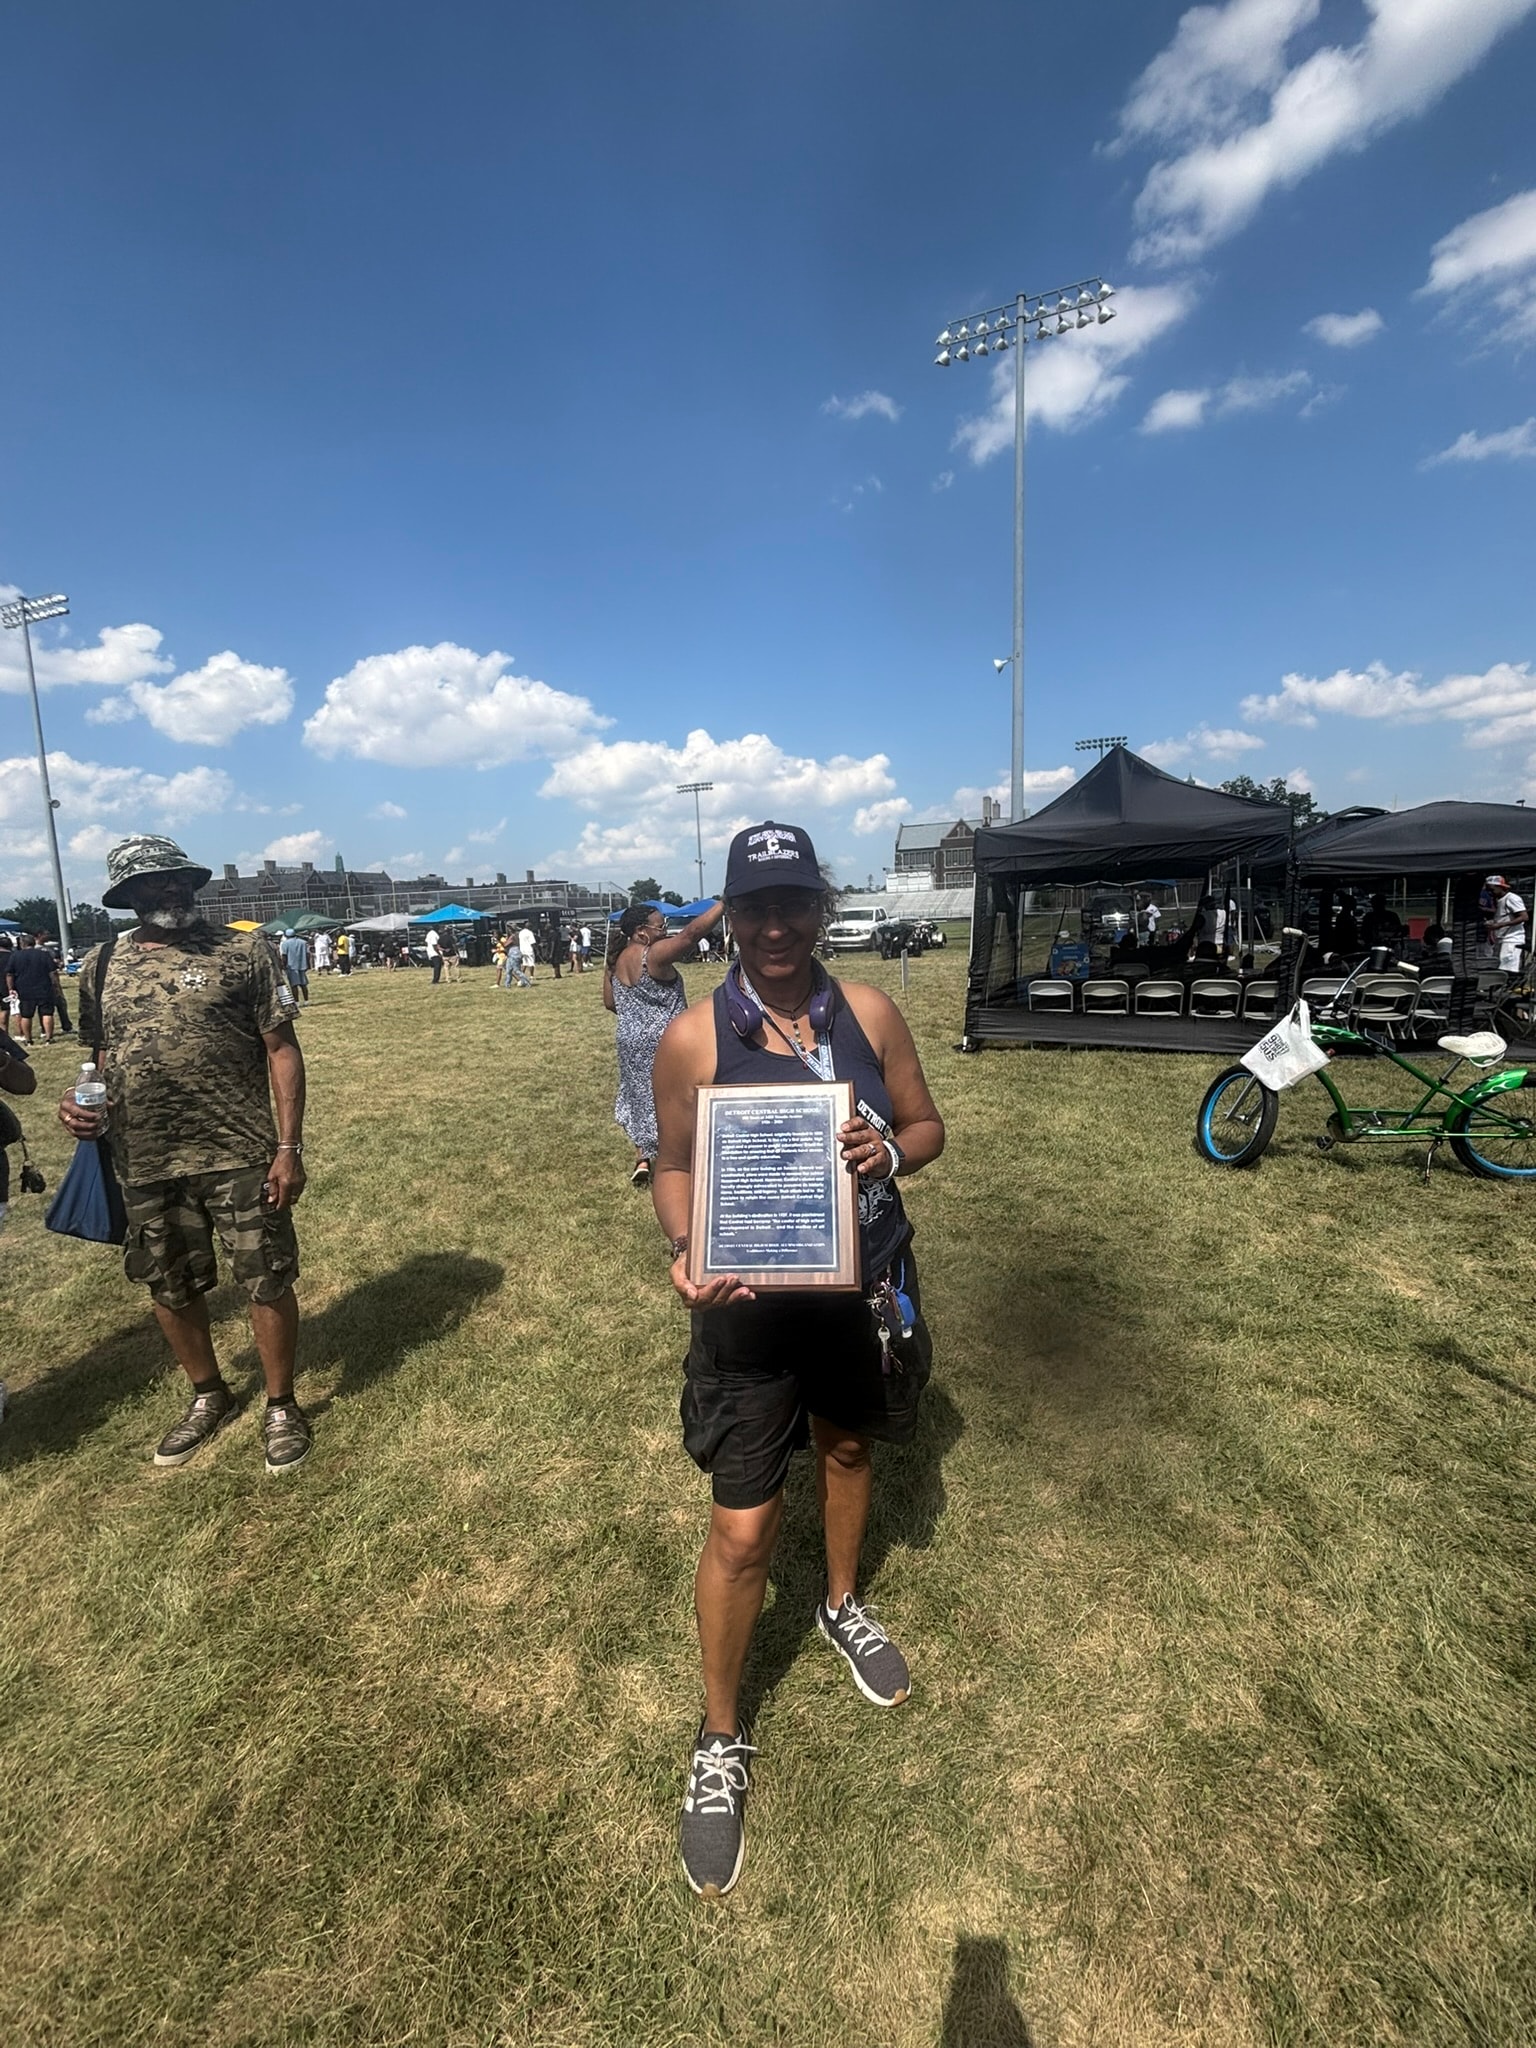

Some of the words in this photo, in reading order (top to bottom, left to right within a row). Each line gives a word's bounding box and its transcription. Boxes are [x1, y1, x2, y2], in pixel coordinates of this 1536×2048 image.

[767, 838, 780, 850] C
[747, 849, 799, 862] TRAILBLAZERS
[856, 1099, 886, 1132] DETROIT
